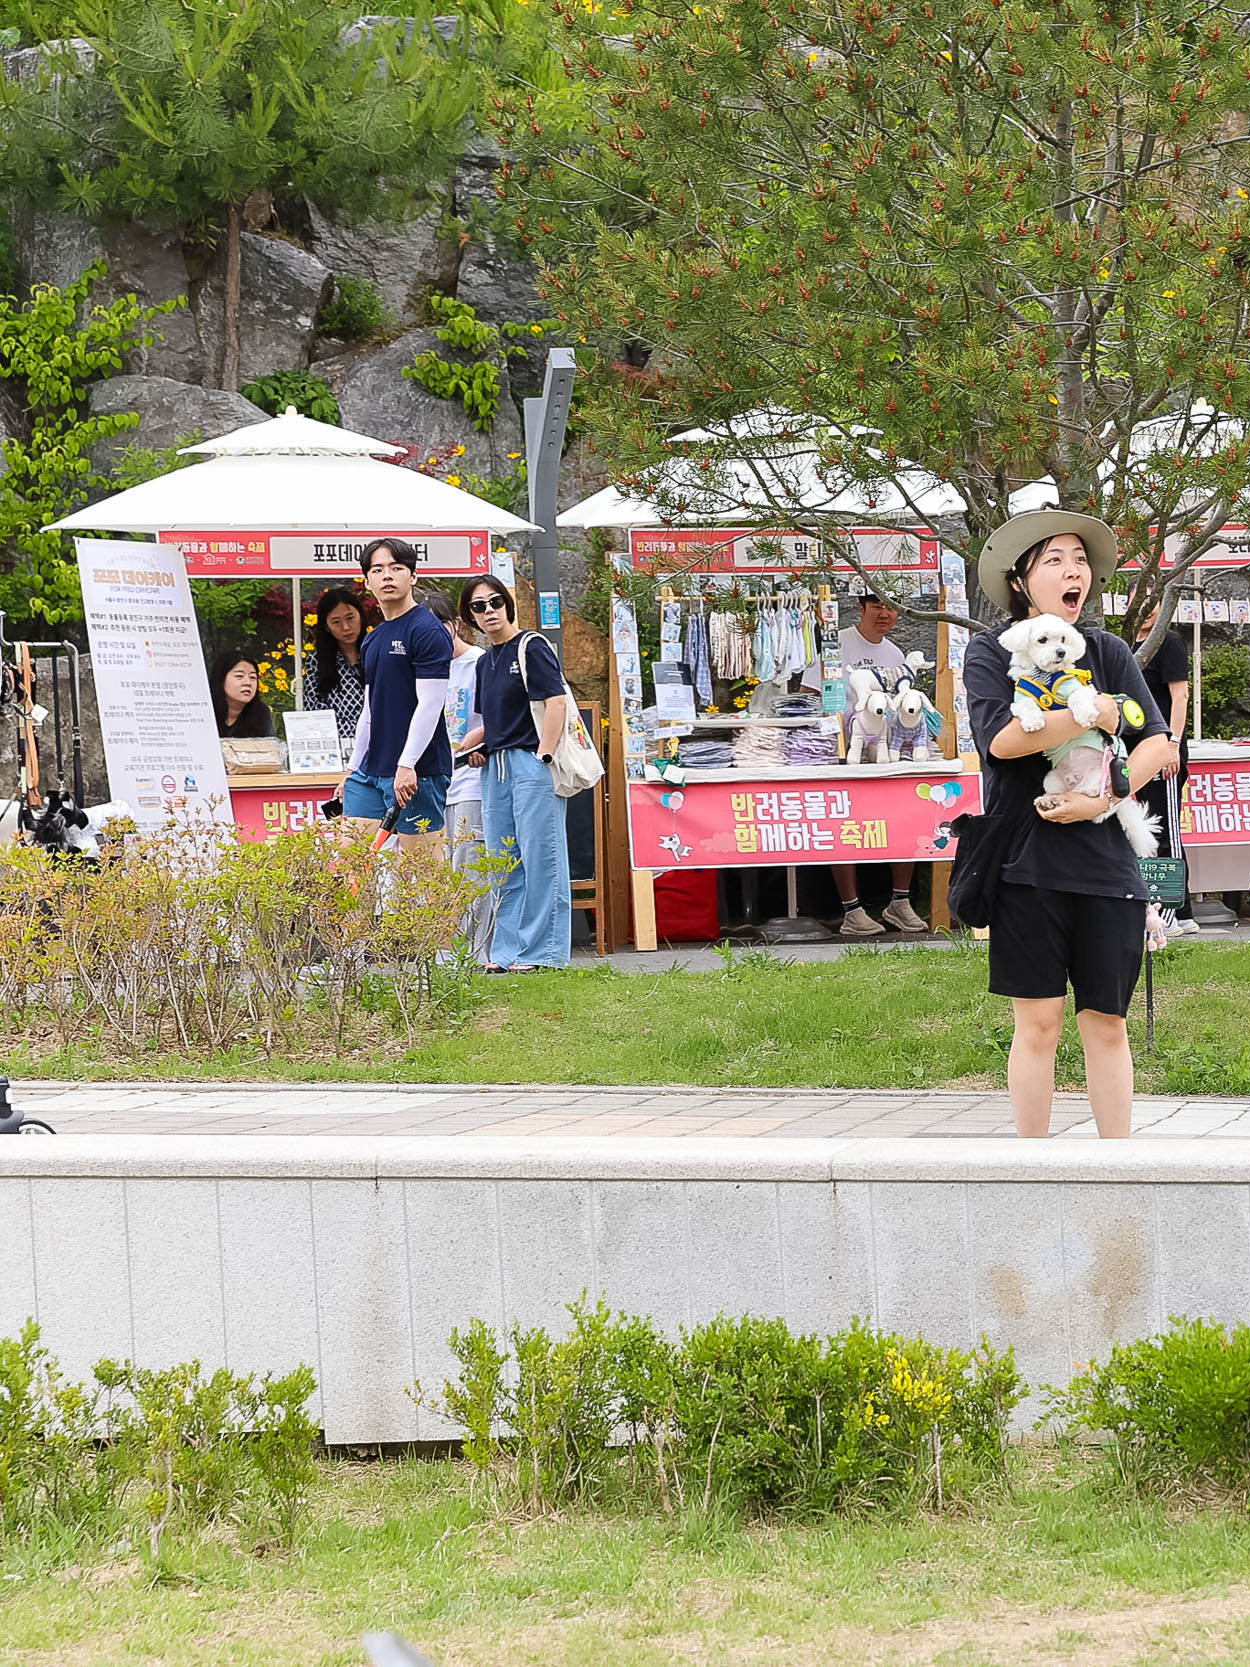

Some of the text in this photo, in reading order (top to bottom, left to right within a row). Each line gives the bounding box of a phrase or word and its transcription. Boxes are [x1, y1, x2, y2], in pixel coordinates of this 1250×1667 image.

[210, 541, 246, 553] 함께하는
[247, 541, 266, 553] 축제
[730, 790, 852, 822] 반려동물과
[733, 819, 889, 853] 함께하는 축제
[1139, 863, 1158, 872] 나19
[1140, 872, 1167, 881] 망나무
